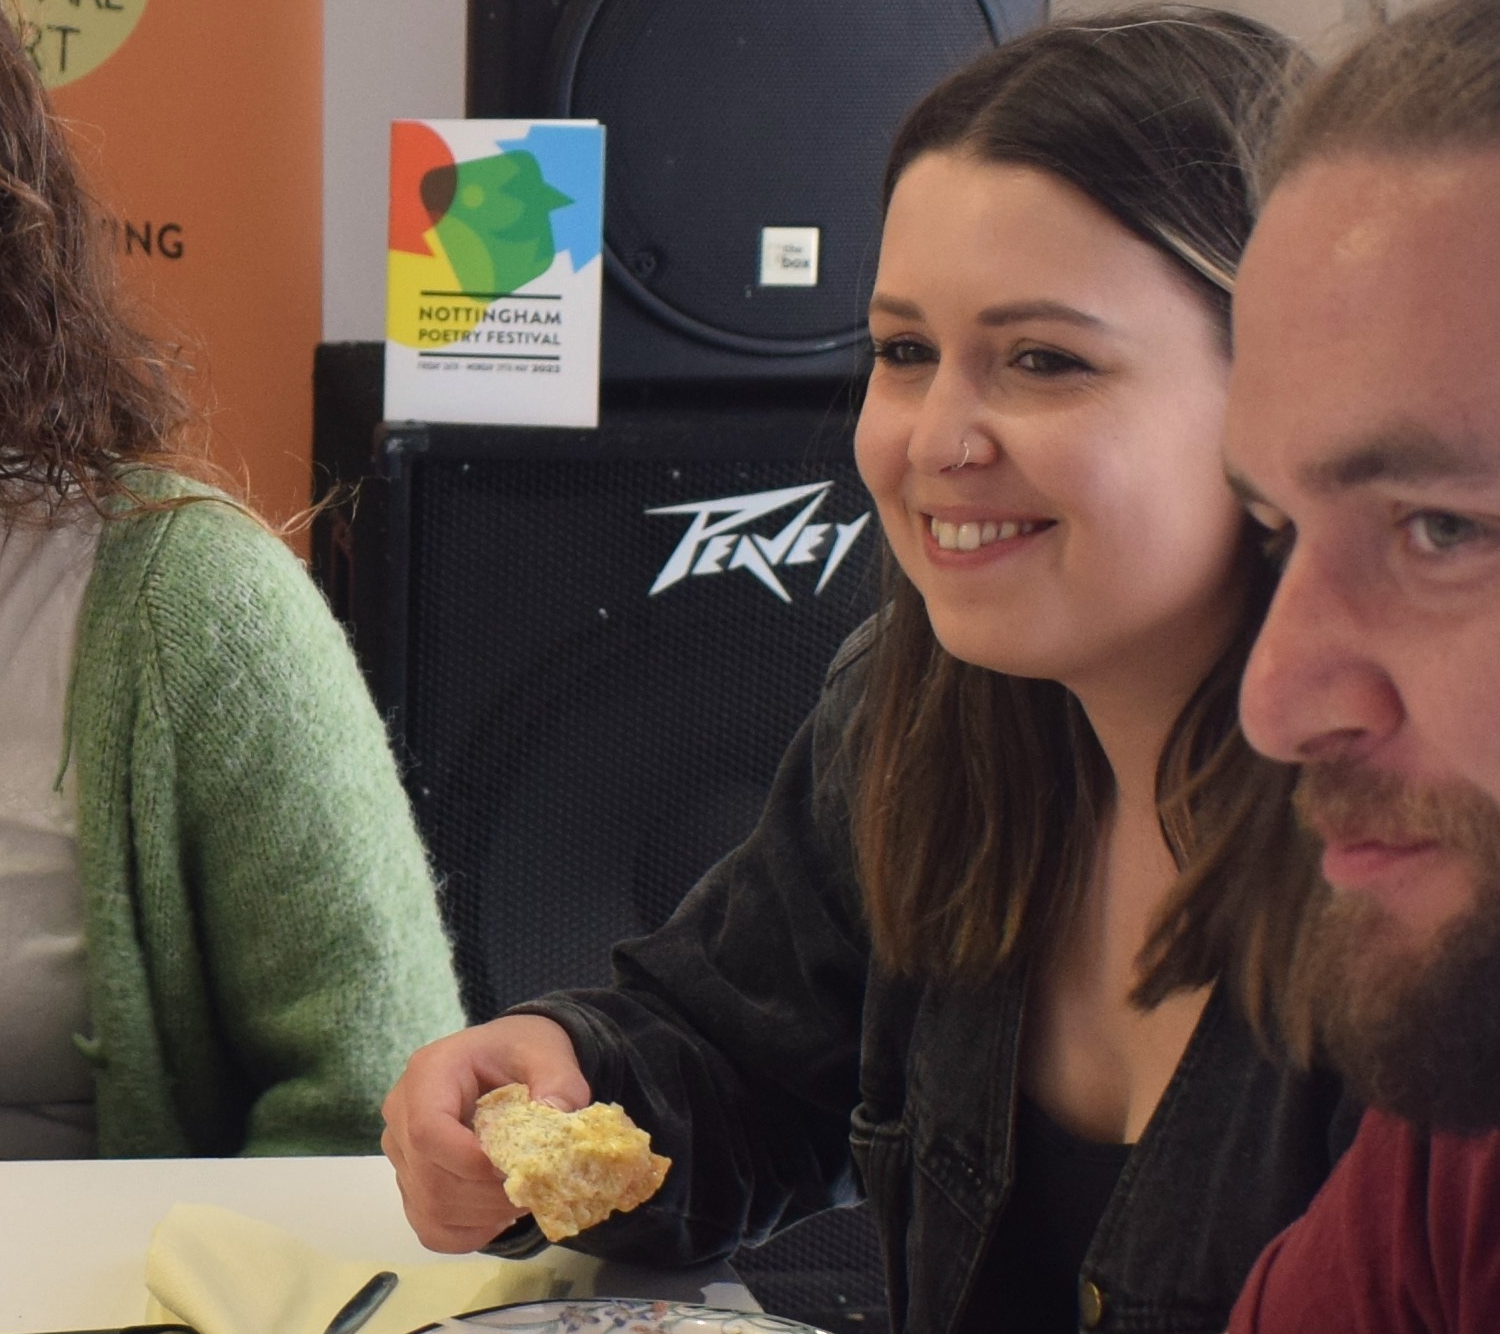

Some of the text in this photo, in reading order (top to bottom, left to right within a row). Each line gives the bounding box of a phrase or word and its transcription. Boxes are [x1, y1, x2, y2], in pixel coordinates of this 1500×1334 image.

[417, 304, 564, 328] NOTTINGHAM
[417, 328, 562, 348] POETRY FESTIVAL
[643, 480, 871, 604] PEAVEY
